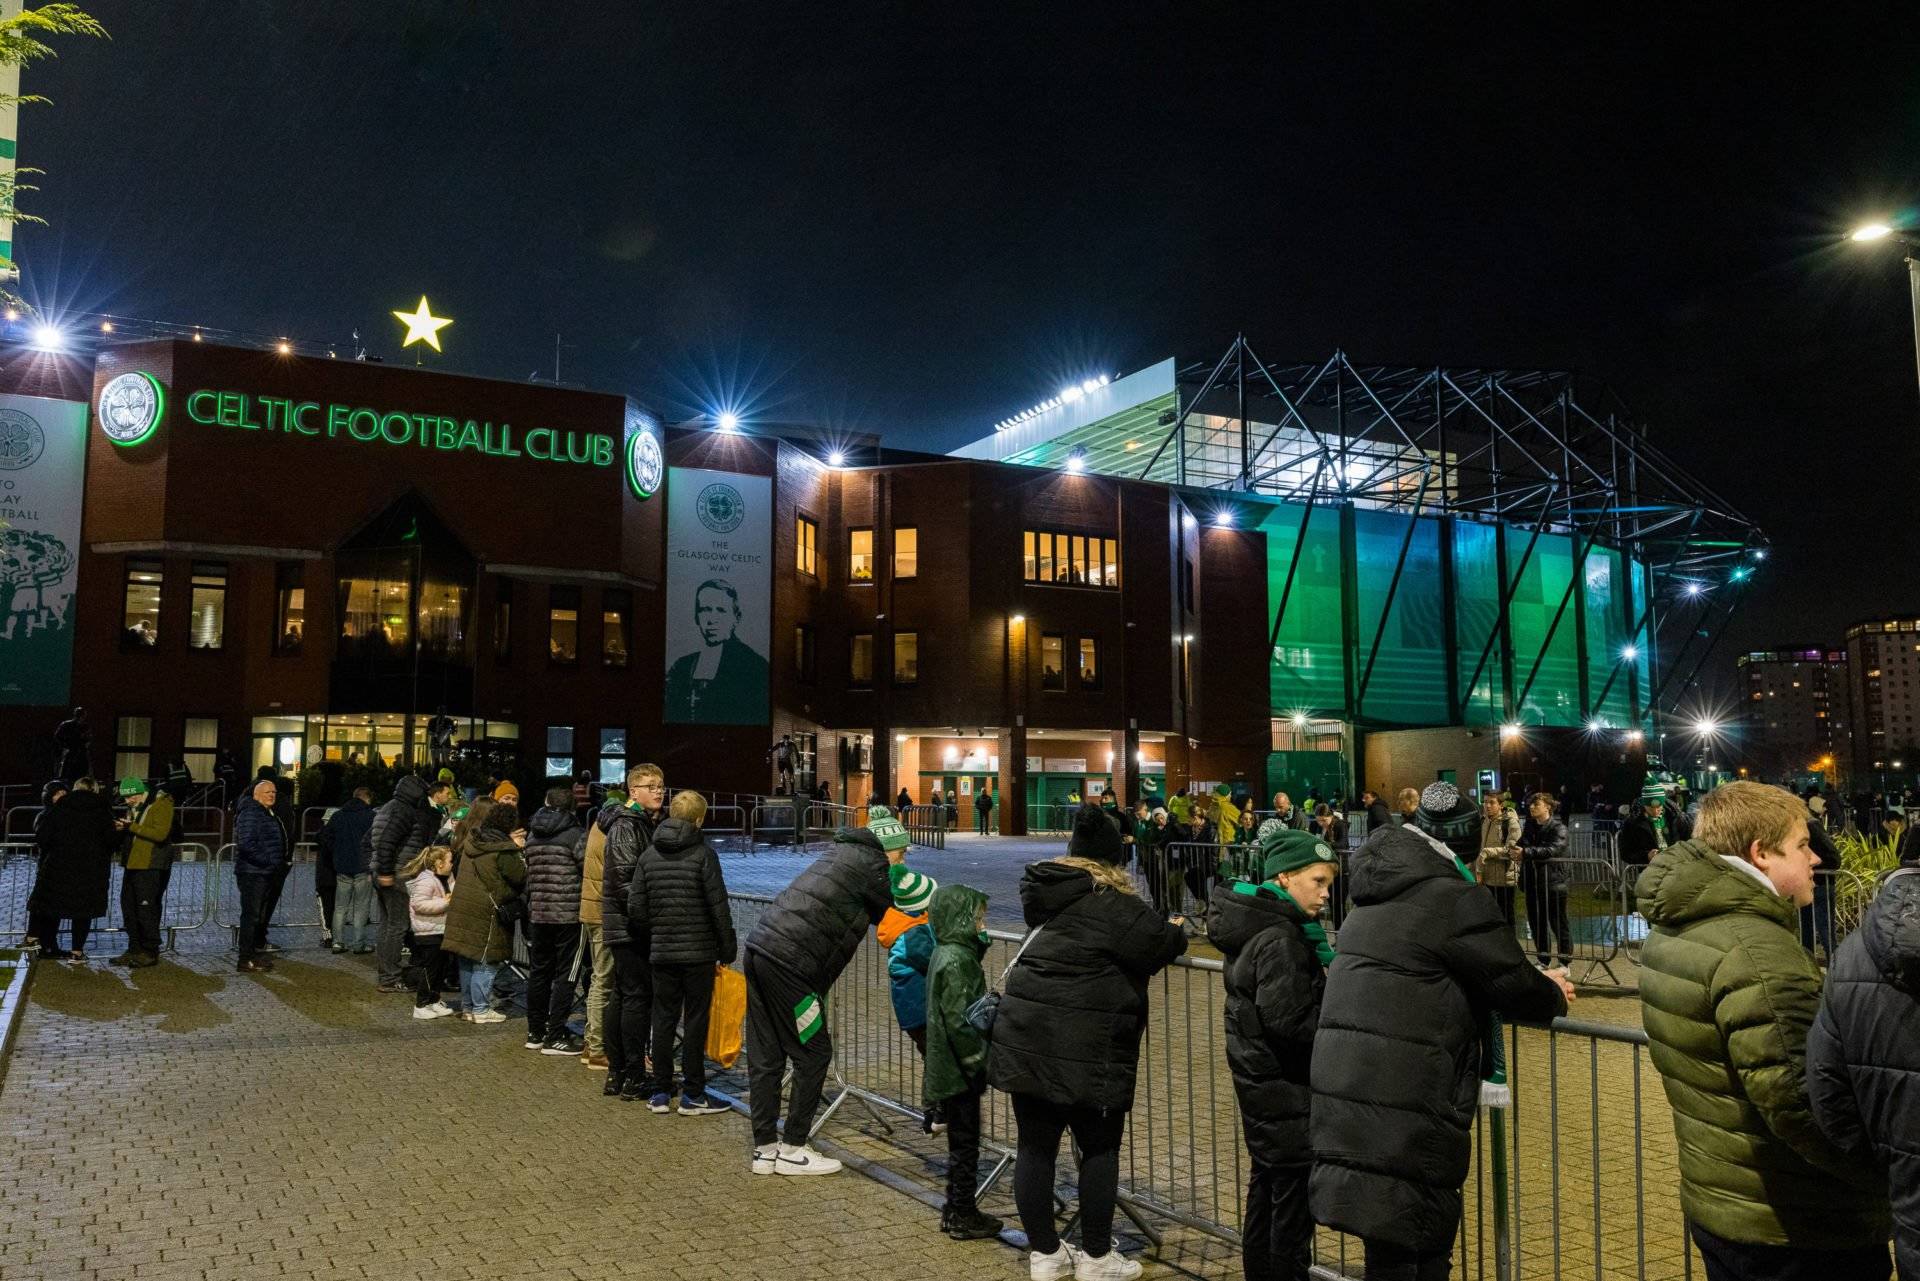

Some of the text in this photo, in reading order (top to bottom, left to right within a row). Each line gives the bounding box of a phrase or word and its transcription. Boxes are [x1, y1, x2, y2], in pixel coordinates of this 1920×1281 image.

[187, 389, 320, 435] CELTIC
[328, 403, 521, 456] FOOTBALL
[526, 428, 614, 466] CLUB
[0, 494, 21, 505] AY
[711, 540, 729, 550] THE
[677, 549, 762, 564] GLASGOW CELTIC
[709, 563, 730, 573] WAY
[873, 824, 904, 838] ELTI
